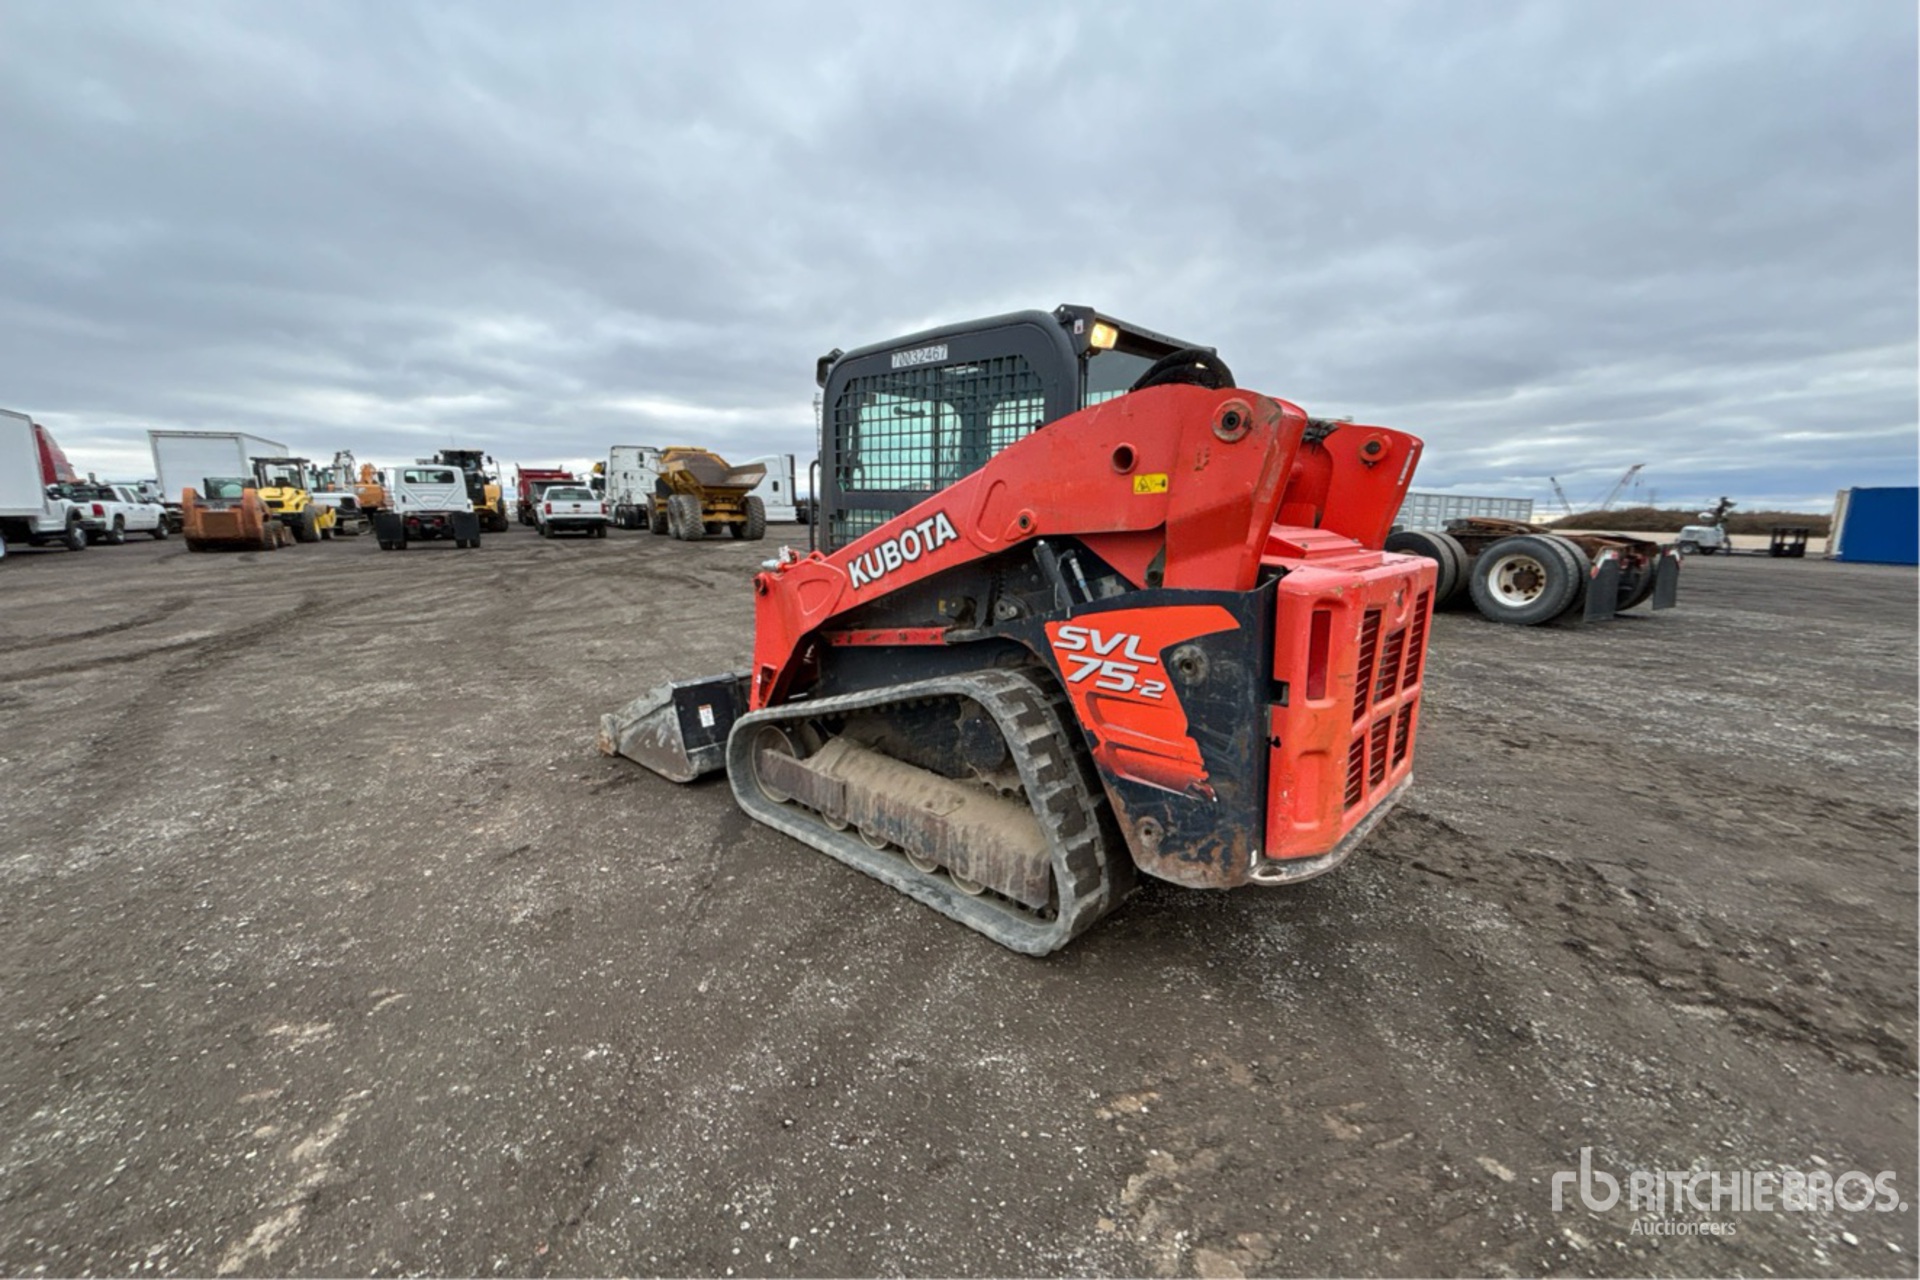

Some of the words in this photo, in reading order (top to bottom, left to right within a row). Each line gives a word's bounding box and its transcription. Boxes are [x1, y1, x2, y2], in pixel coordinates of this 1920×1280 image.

[892, 344, 948, 368] 70032467
[847, 511, 959, 590] KUBOTA
[1053, 625, 1158, 664] SVL
[1067, 653, 1167, 699] 75-2
